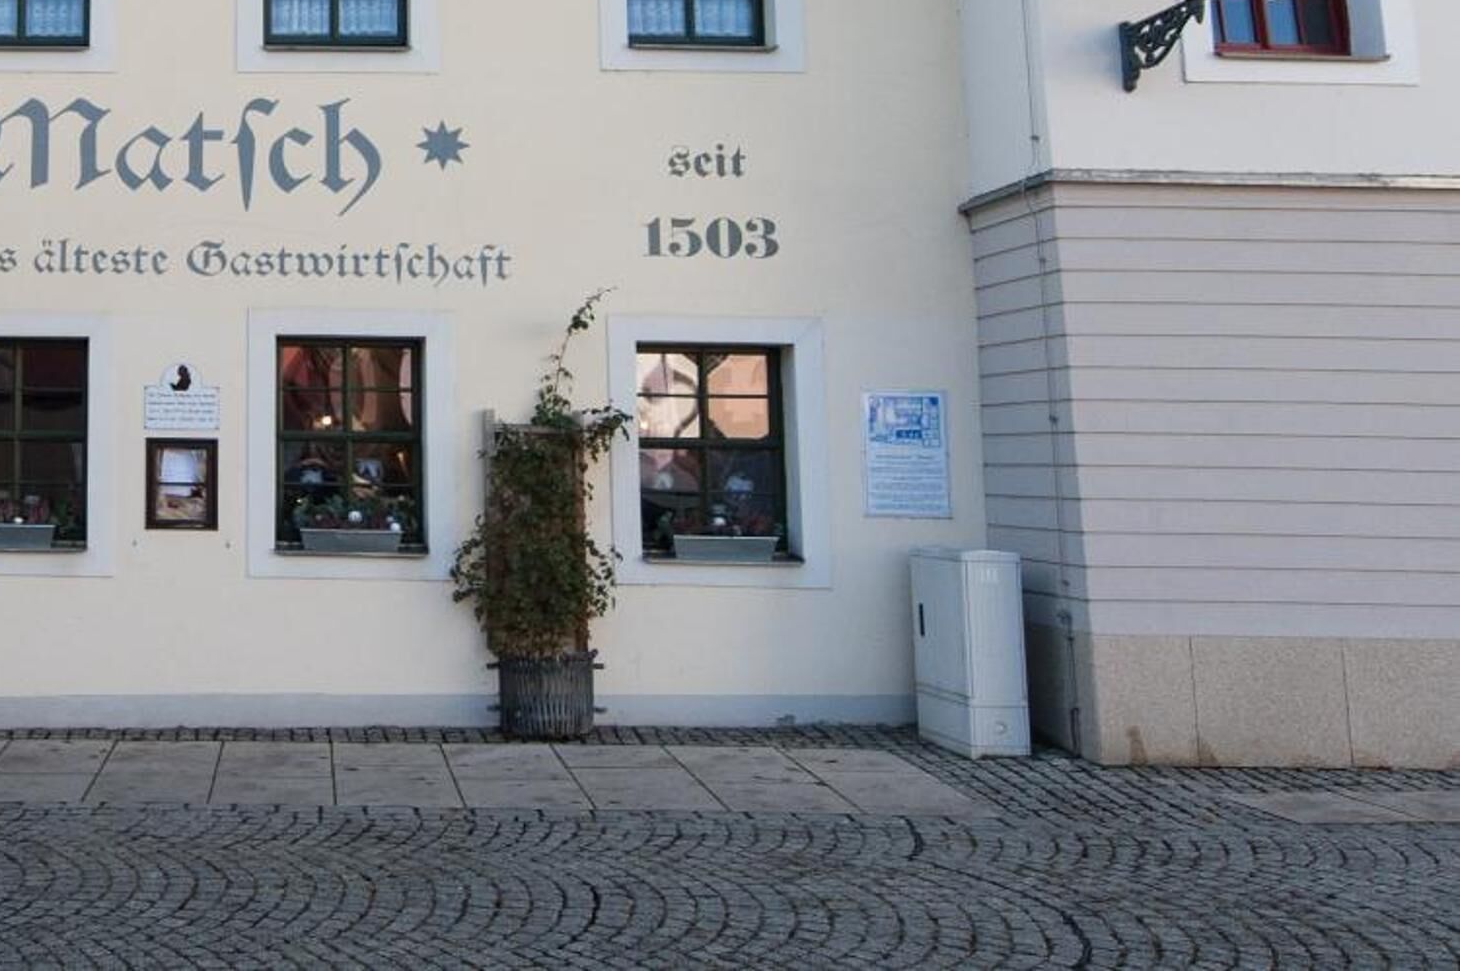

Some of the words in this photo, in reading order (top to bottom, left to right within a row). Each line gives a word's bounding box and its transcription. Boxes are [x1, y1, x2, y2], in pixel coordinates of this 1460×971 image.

[667, 143, 746, 178] seit
[642, 216, 780, 259] 1503
[33, 238, 168, 275] älteste
